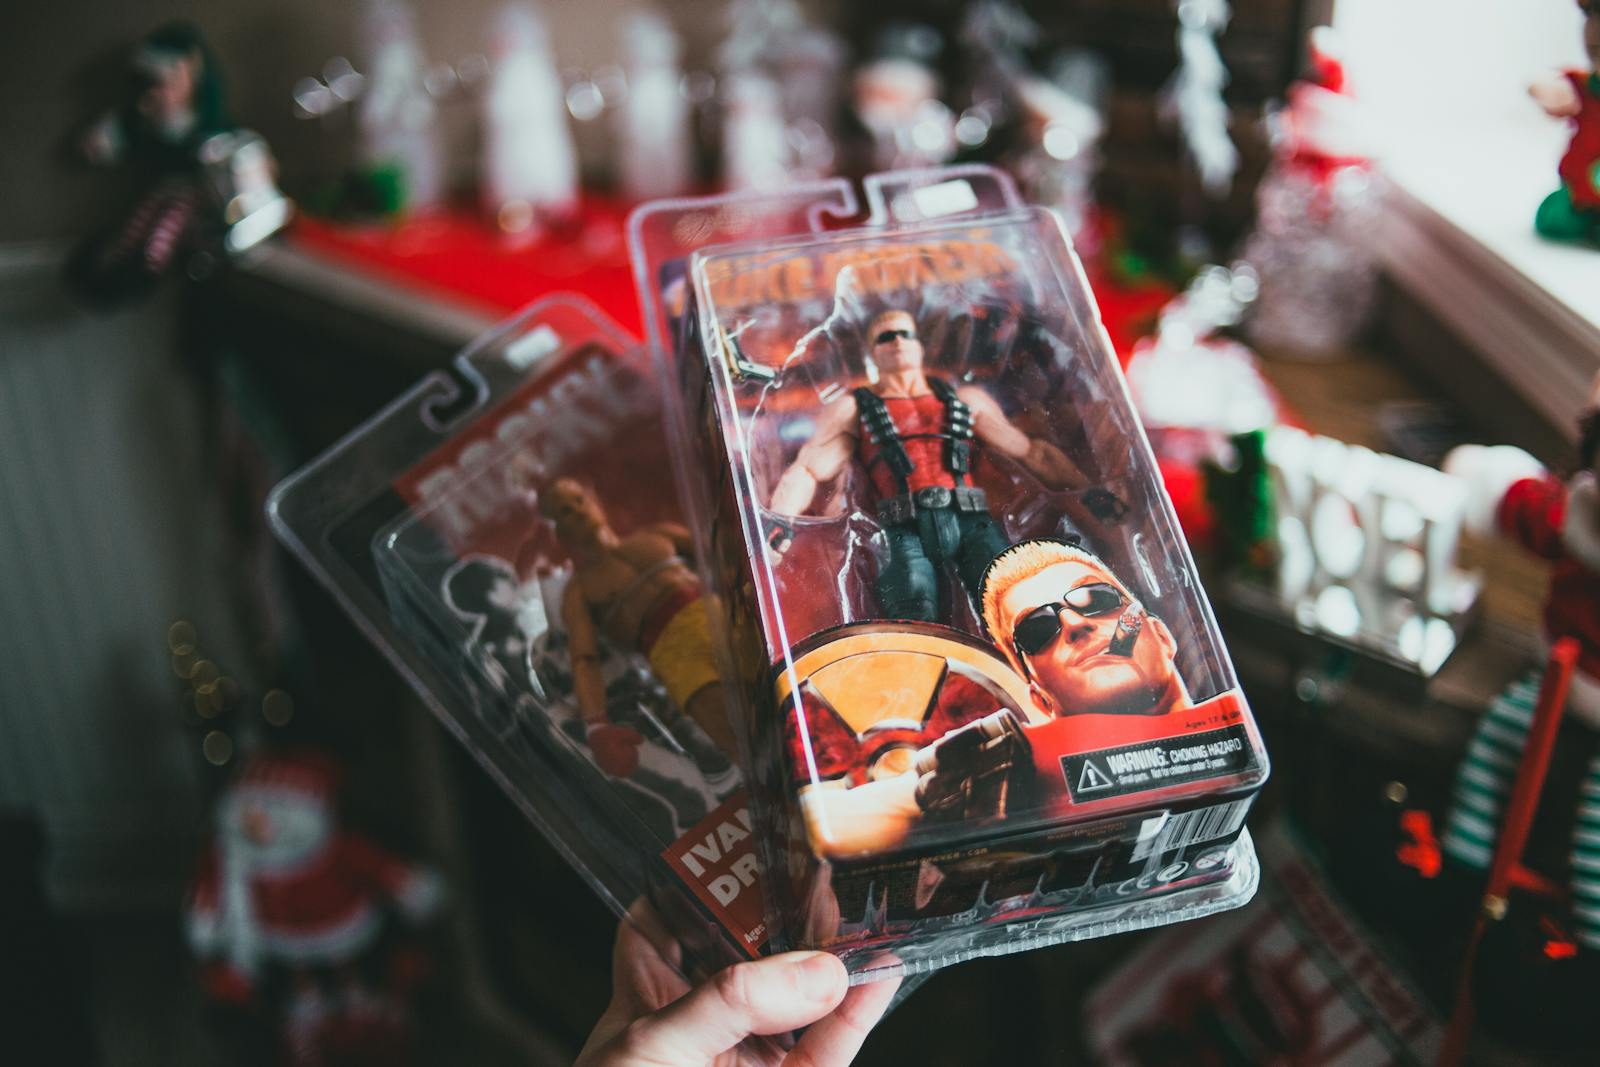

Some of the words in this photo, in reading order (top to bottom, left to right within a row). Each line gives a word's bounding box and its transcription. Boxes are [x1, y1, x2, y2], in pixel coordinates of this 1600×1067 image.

[1106, 747, 1169, 775] WARNING:
[1169, 744, 1209, 764] CHOKING
[1208, 738, 1242, 757] HAZARD
[744, 925, 766, 944] Ages
